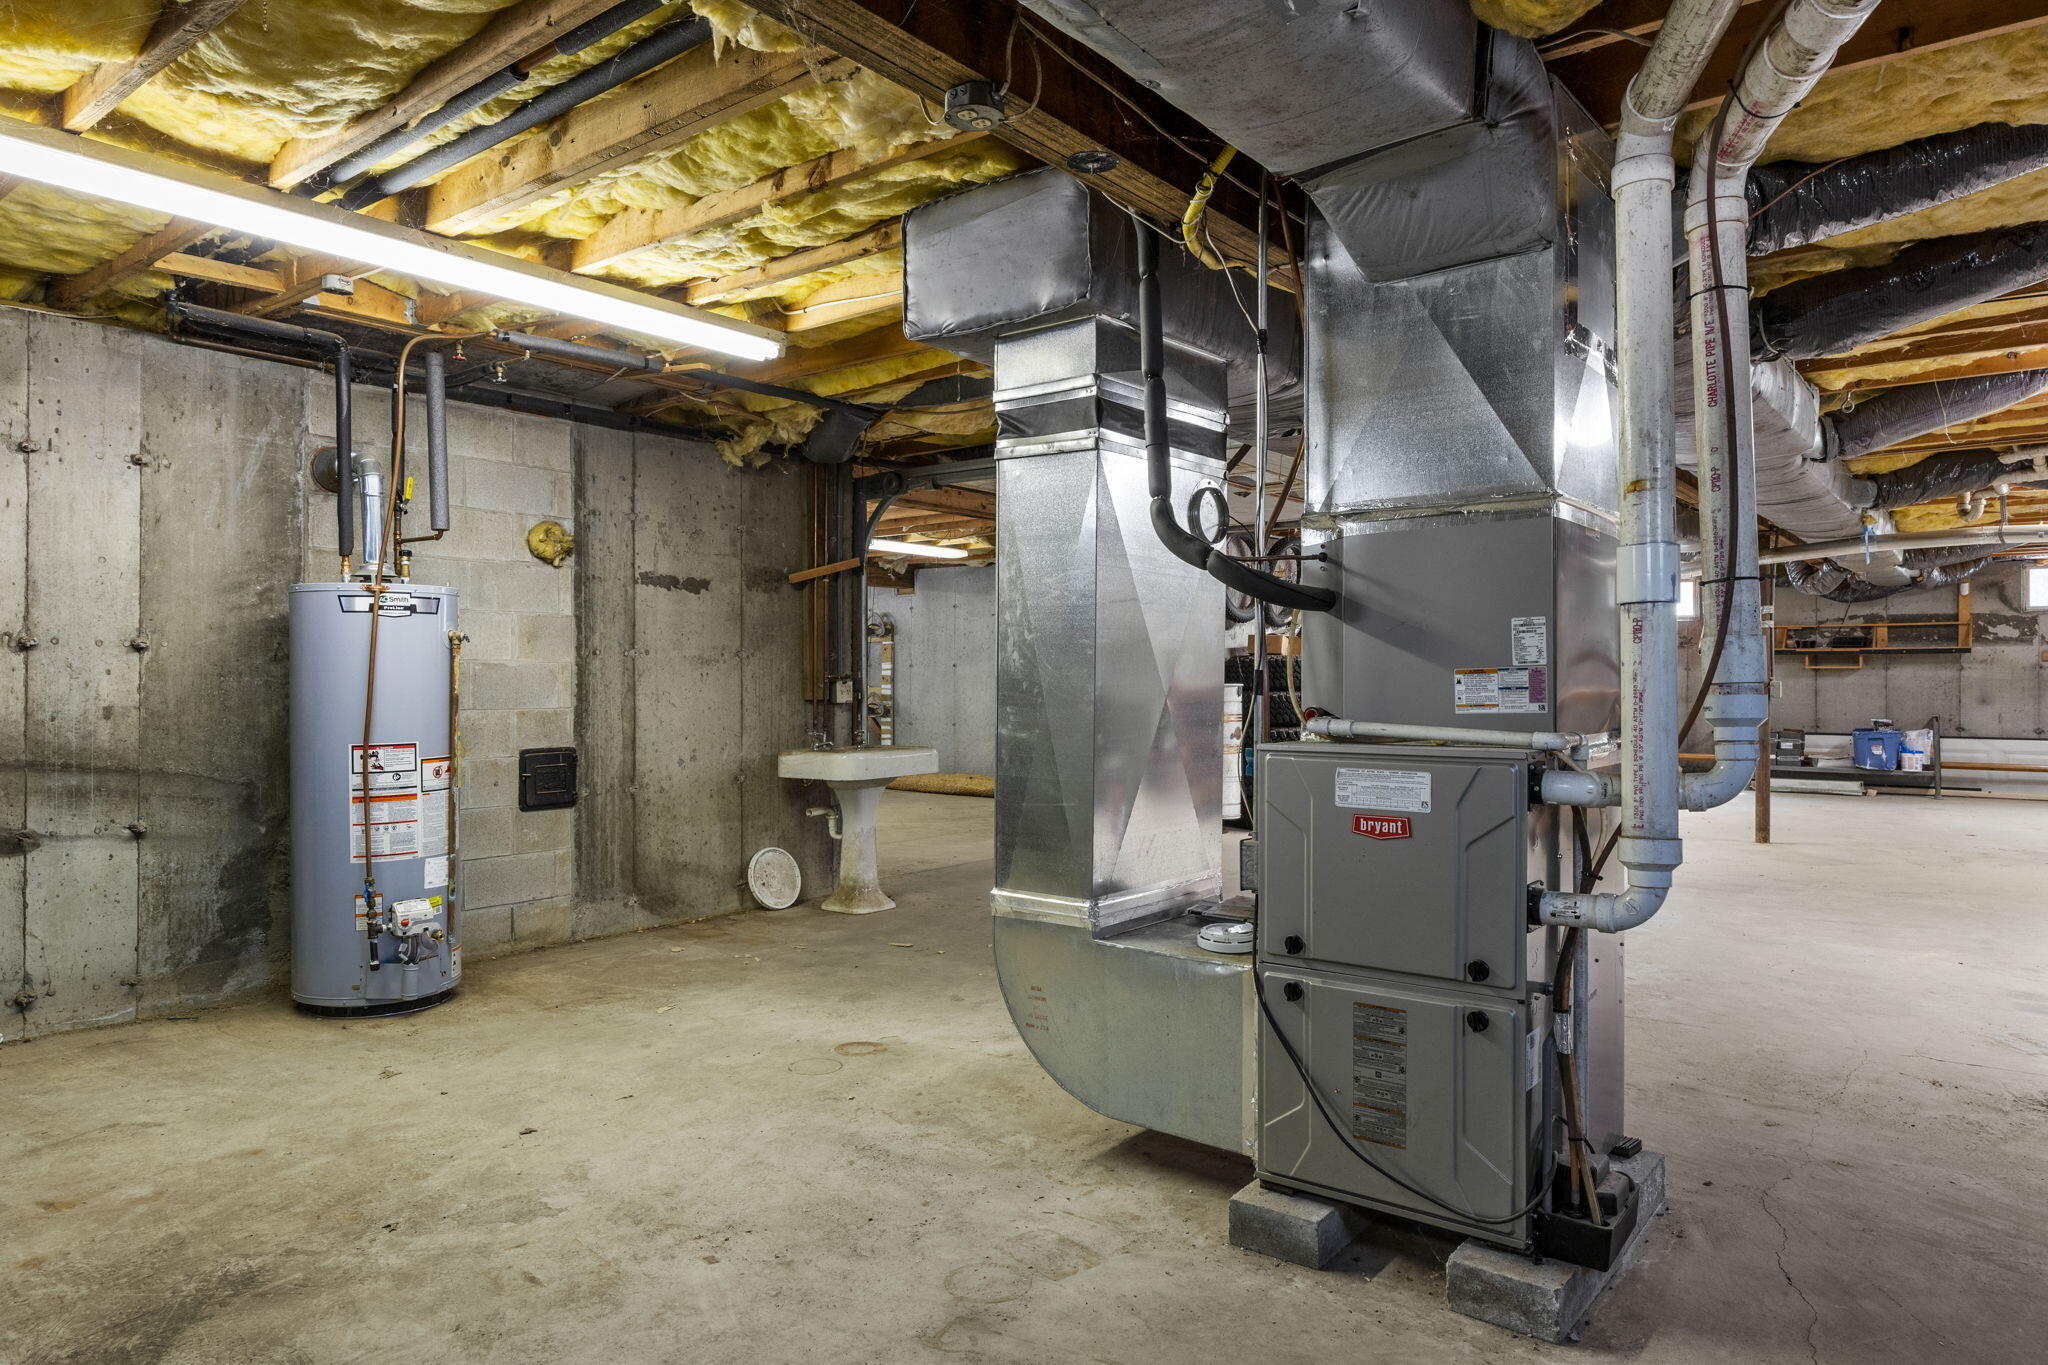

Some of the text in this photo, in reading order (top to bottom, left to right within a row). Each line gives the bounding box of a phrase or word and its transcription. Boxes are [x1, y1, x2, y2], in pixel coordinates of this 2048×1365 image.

[1703, 320, 1718, 408] CHARLOTTE PIPE N/E
[1633, 724, 1638, 733] 40
[1360, 818, 1402, 834] bryant
